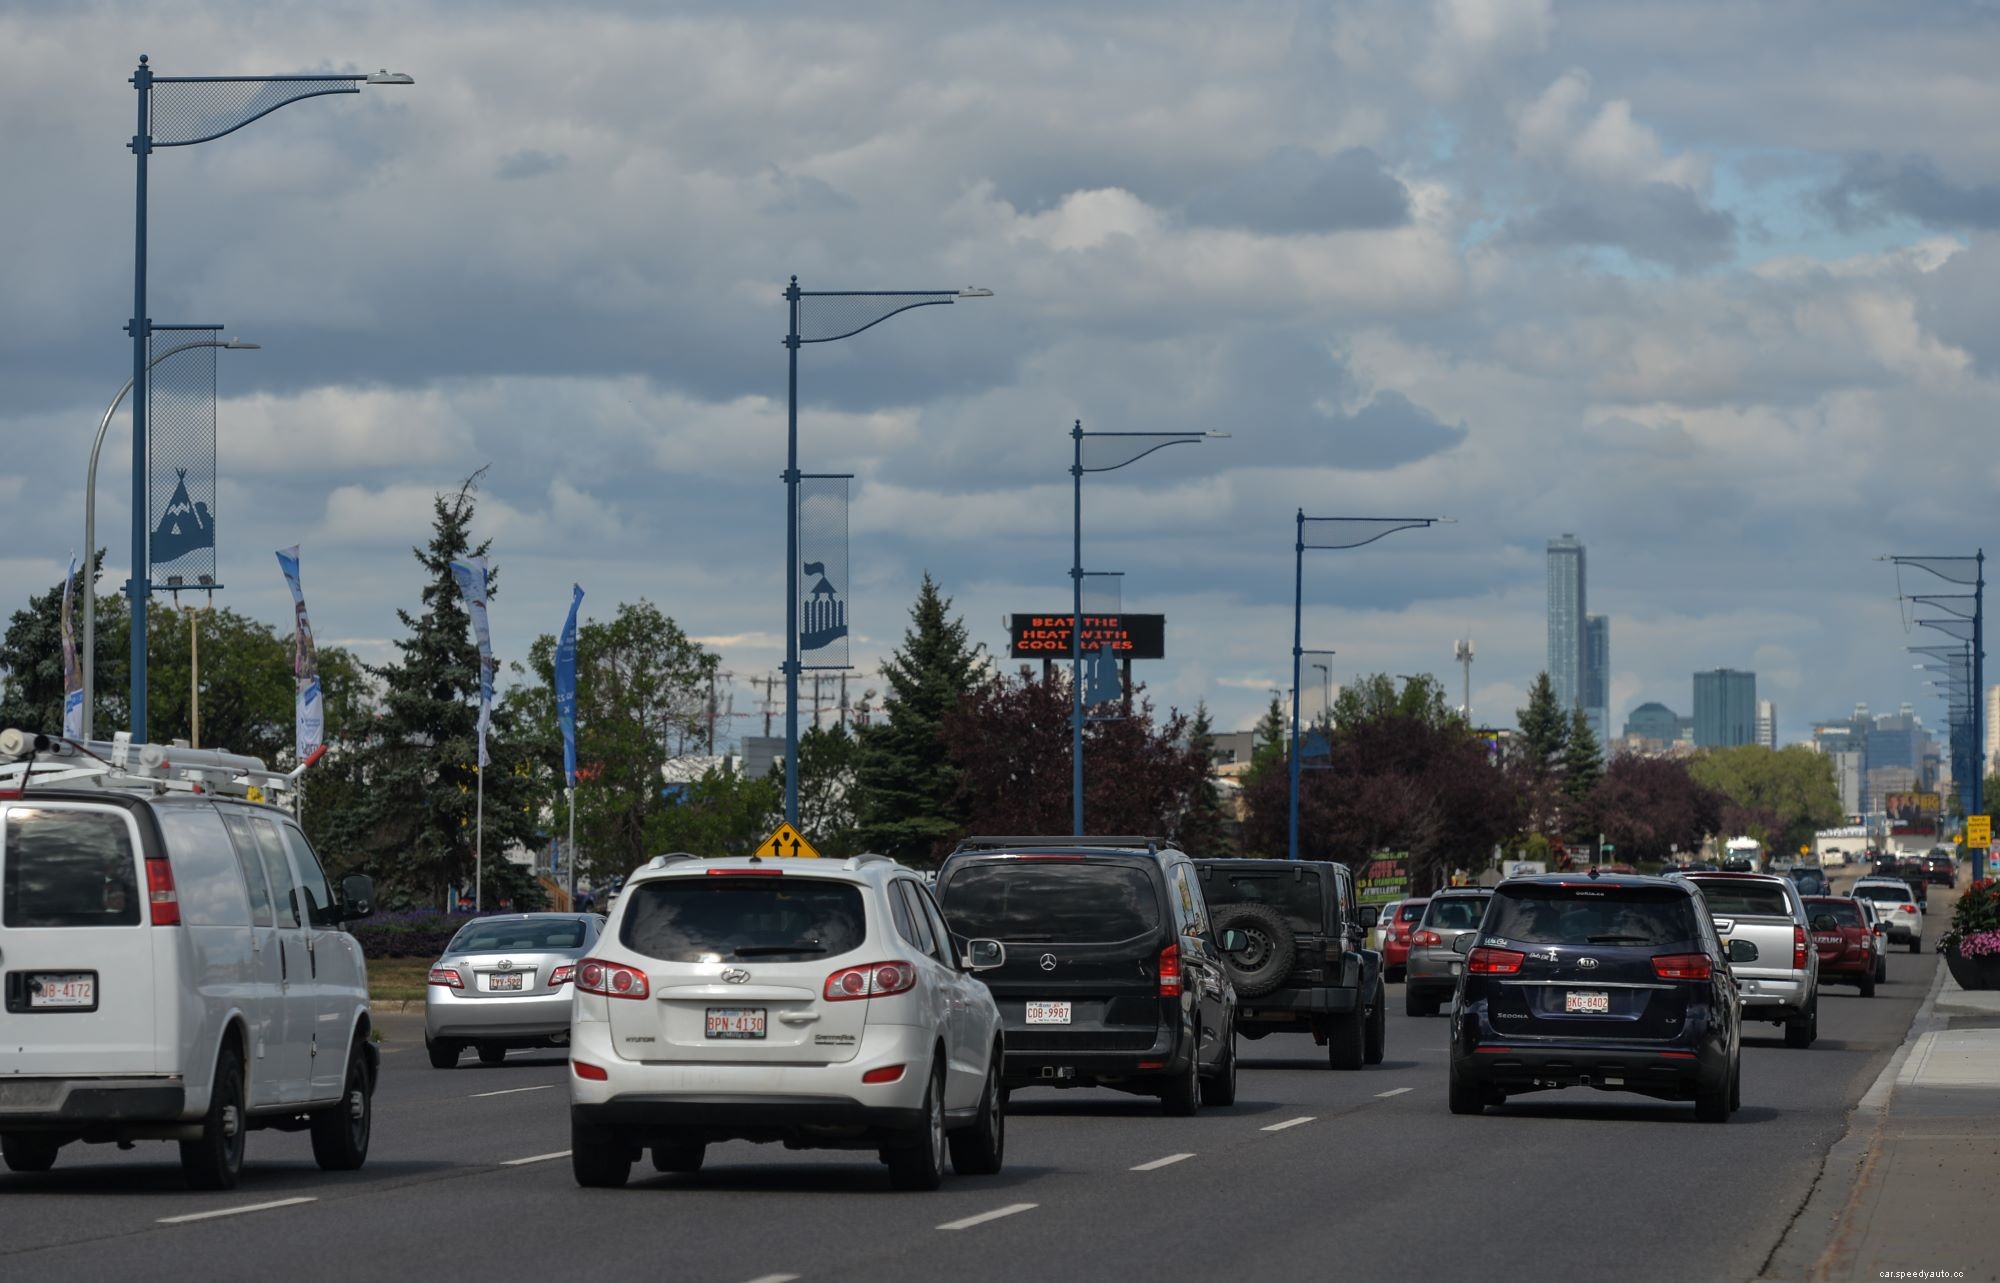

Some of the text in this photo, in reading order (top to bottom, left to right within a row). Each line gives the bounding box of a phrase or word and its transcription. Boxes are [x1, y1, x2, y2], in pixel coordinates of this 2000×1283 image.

[1032, 617, 1118, 627] BEAT THE
[1023, 630, 1071, 639] HEAT
[1018, 641, 1068, 649] COOL
[1813, 936, 1843, 944] UZUKI
[1581, 959, 1595, 967] KIA
[1567, 997, 1608, 1008] BKG-8402
[1027, 1007, 1069, 1018] CDB-9987
[708, 1016, 764, 1031] BPN-4130
